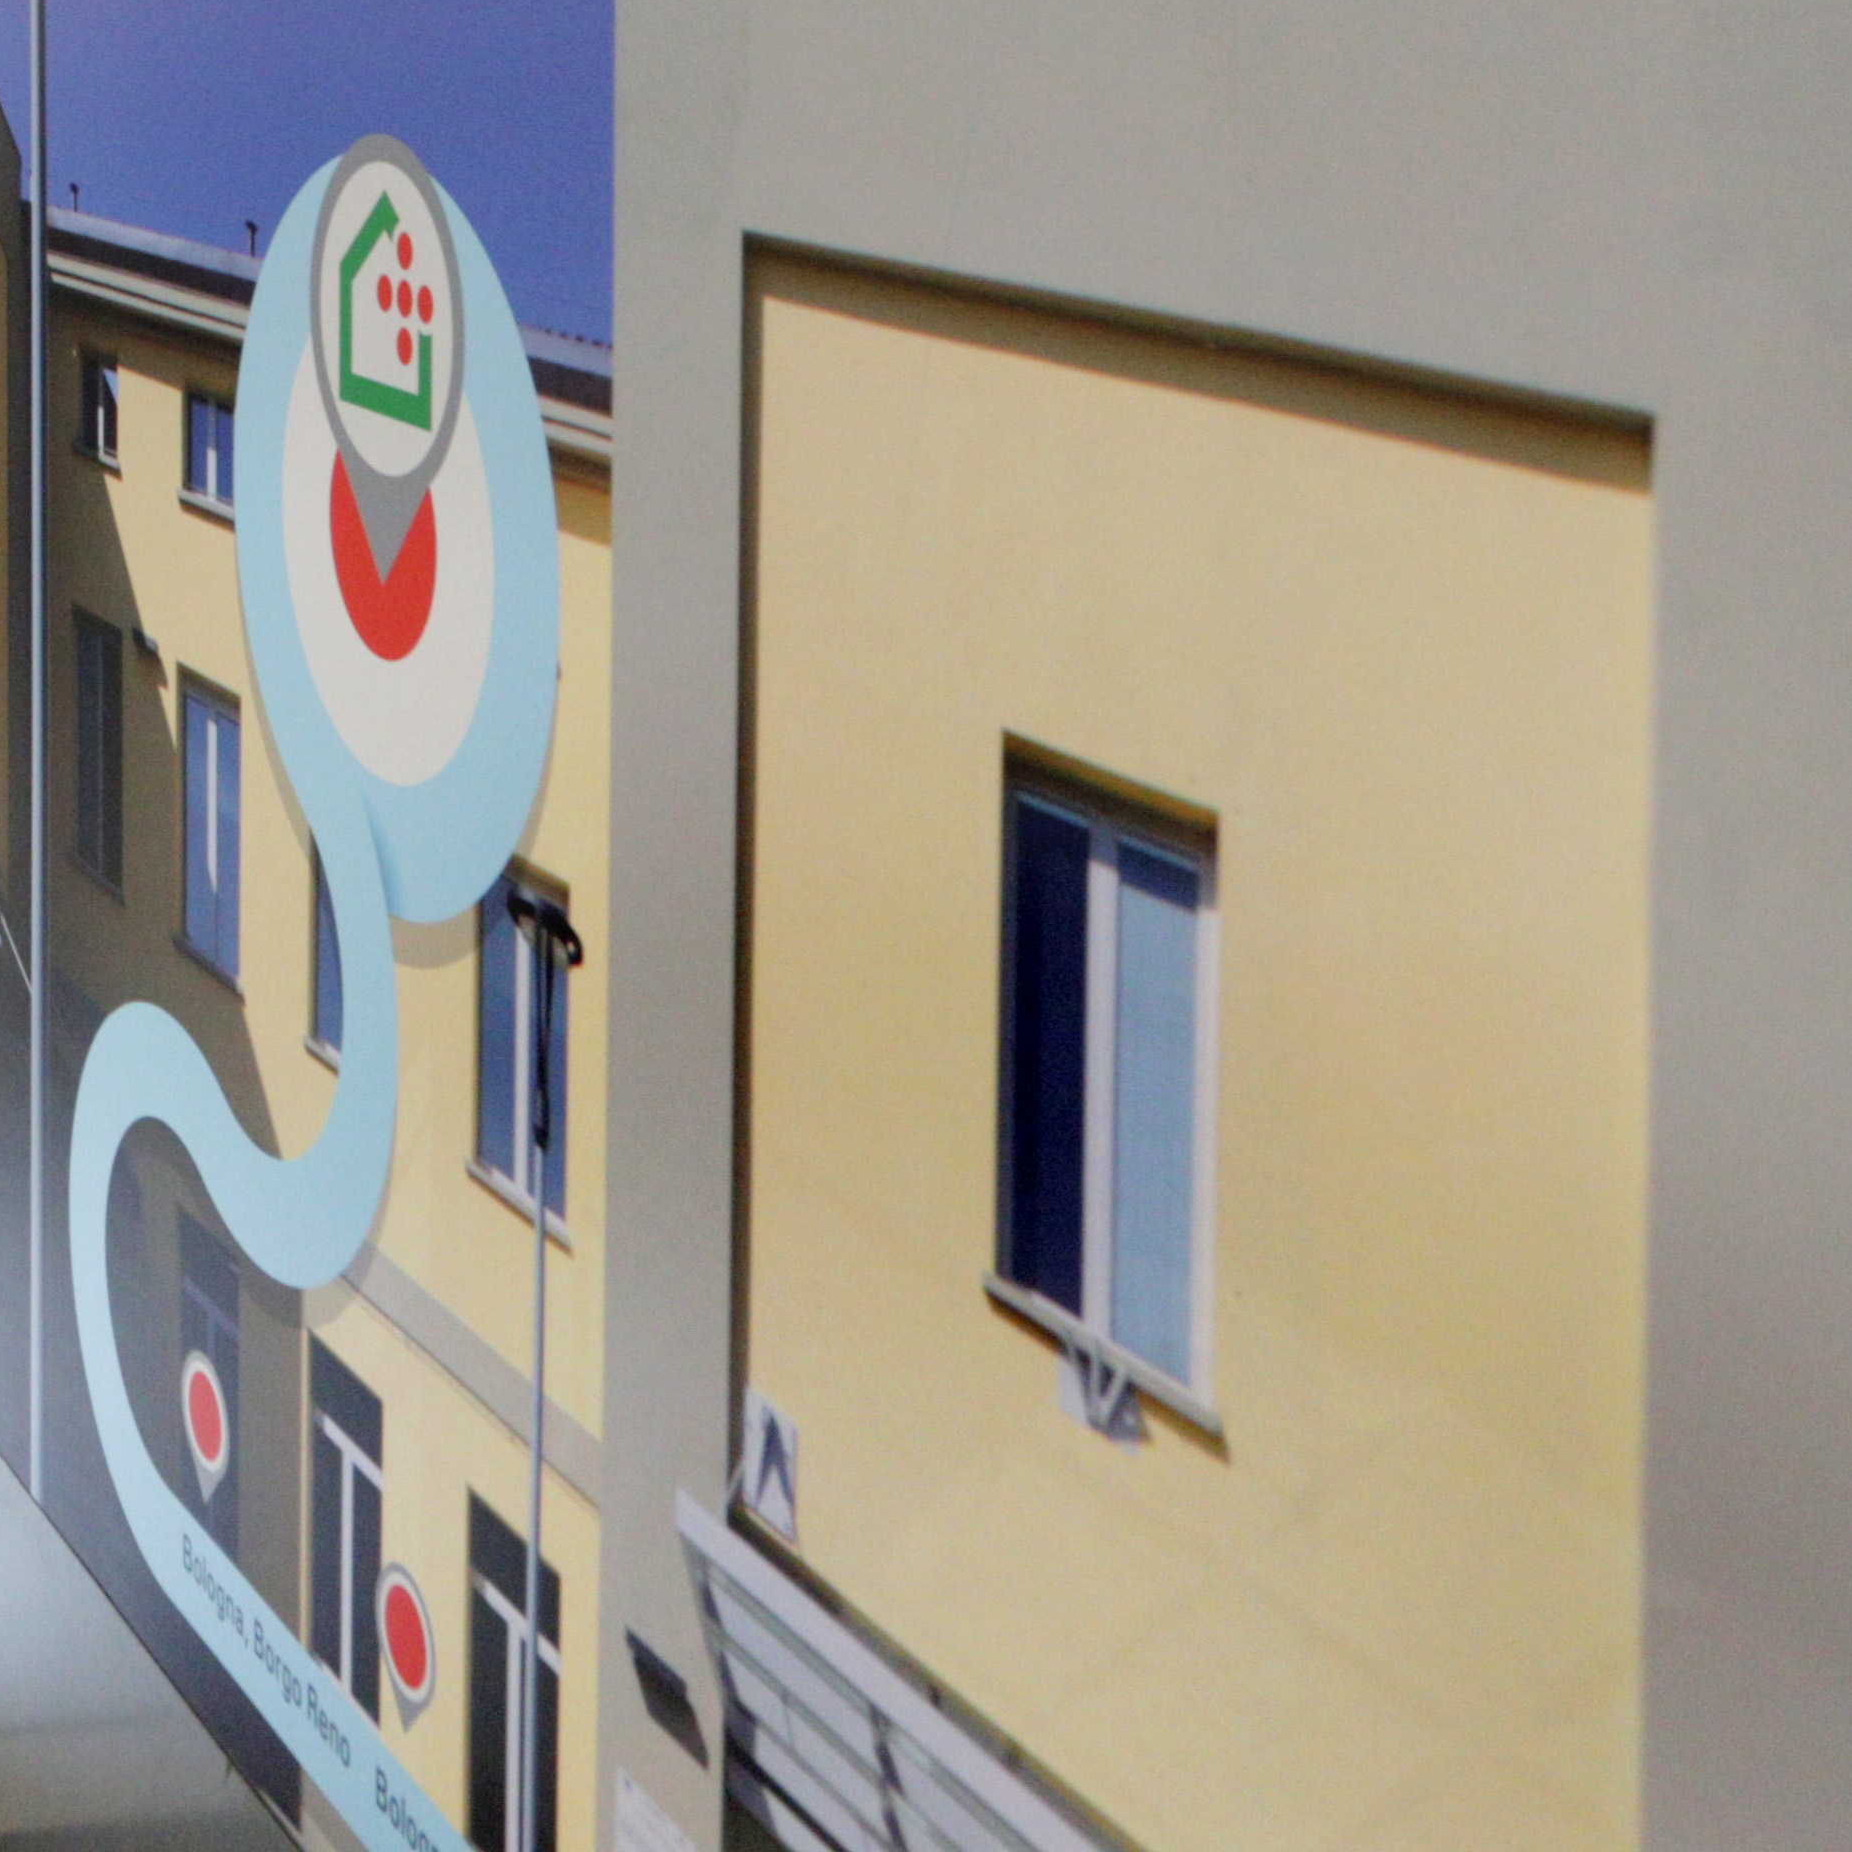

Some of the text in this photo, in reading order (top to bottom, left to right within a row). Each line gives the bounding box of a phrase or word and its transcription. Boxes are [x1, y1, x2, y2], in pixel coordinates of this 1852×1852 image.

[182, 1533, 351, 1767] Bologna, Borgo Reno
[375, 1767, 439, 1852] Bolo
